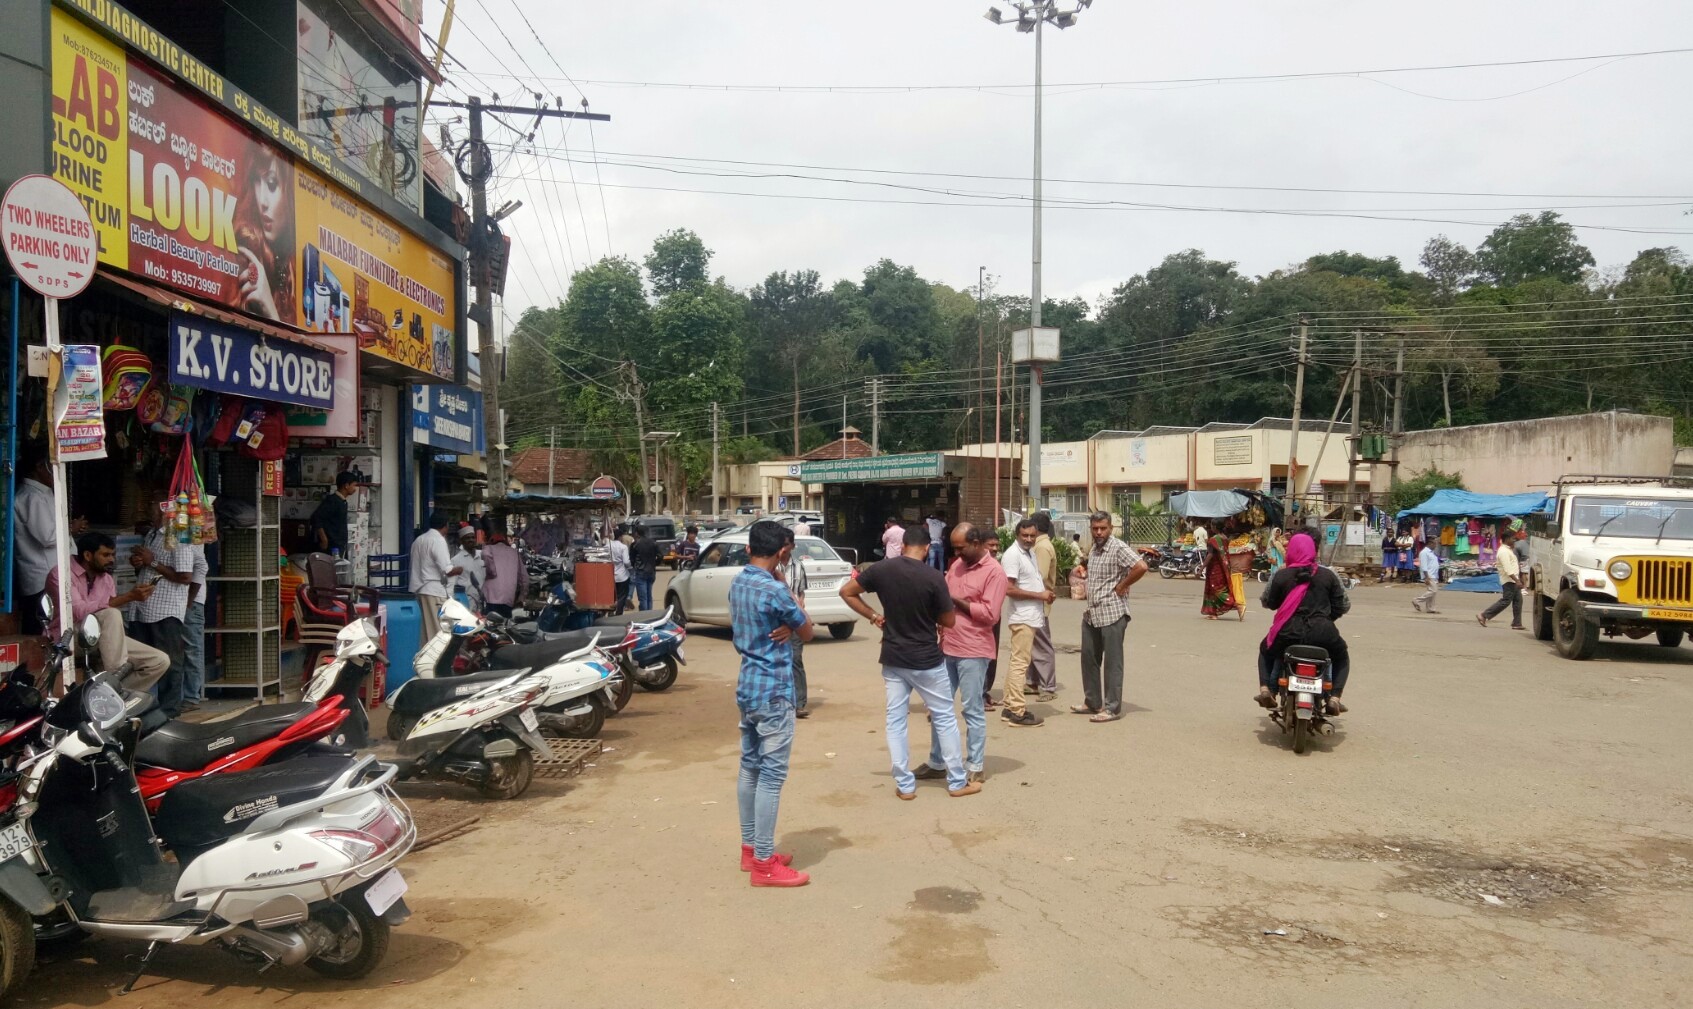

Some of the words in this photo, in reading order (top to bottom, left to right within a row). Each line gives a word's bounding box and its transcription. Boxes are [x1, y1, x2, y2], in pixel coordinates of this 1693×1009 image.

[181, 54, 224, 101] CENTER
[129, 149, 238, 254] LOOK
[7, 204, 32, 227] TWO
[35, 210, 90, 239] WHEELERS
[10, 232, 60, 260] PARKING
[63, 243, 90, 265] ONLY
[130, 224, 168, 252] Herbal
[170, 238, 206, 267] Beauty
[206, 252, 240, 278] Parlour
[144, 260, 169, 282] Mob:
[171, 268, 222, 297] 9535739997
[319, 227, 358, 269] MALABAR
[360, 247, 399, 292] FURNITURE
[399, 277, 405, 293] &
[406, 274, 445, 315] ELECTRONICS
[177, 326, 239, 385] K.V.
[250, 344, 332, 400] STORE
[70, 426, 102, 438] BAZAR
[1650, 609, 1661, 617] KA
[1664, 609, 1672, 617] 12
[235, 802, 255, 812] Divine
[255, 795, 277, 805] Honda
[360, 806, 378, 821] HONDA
[1, 828, 18, 842] 12
